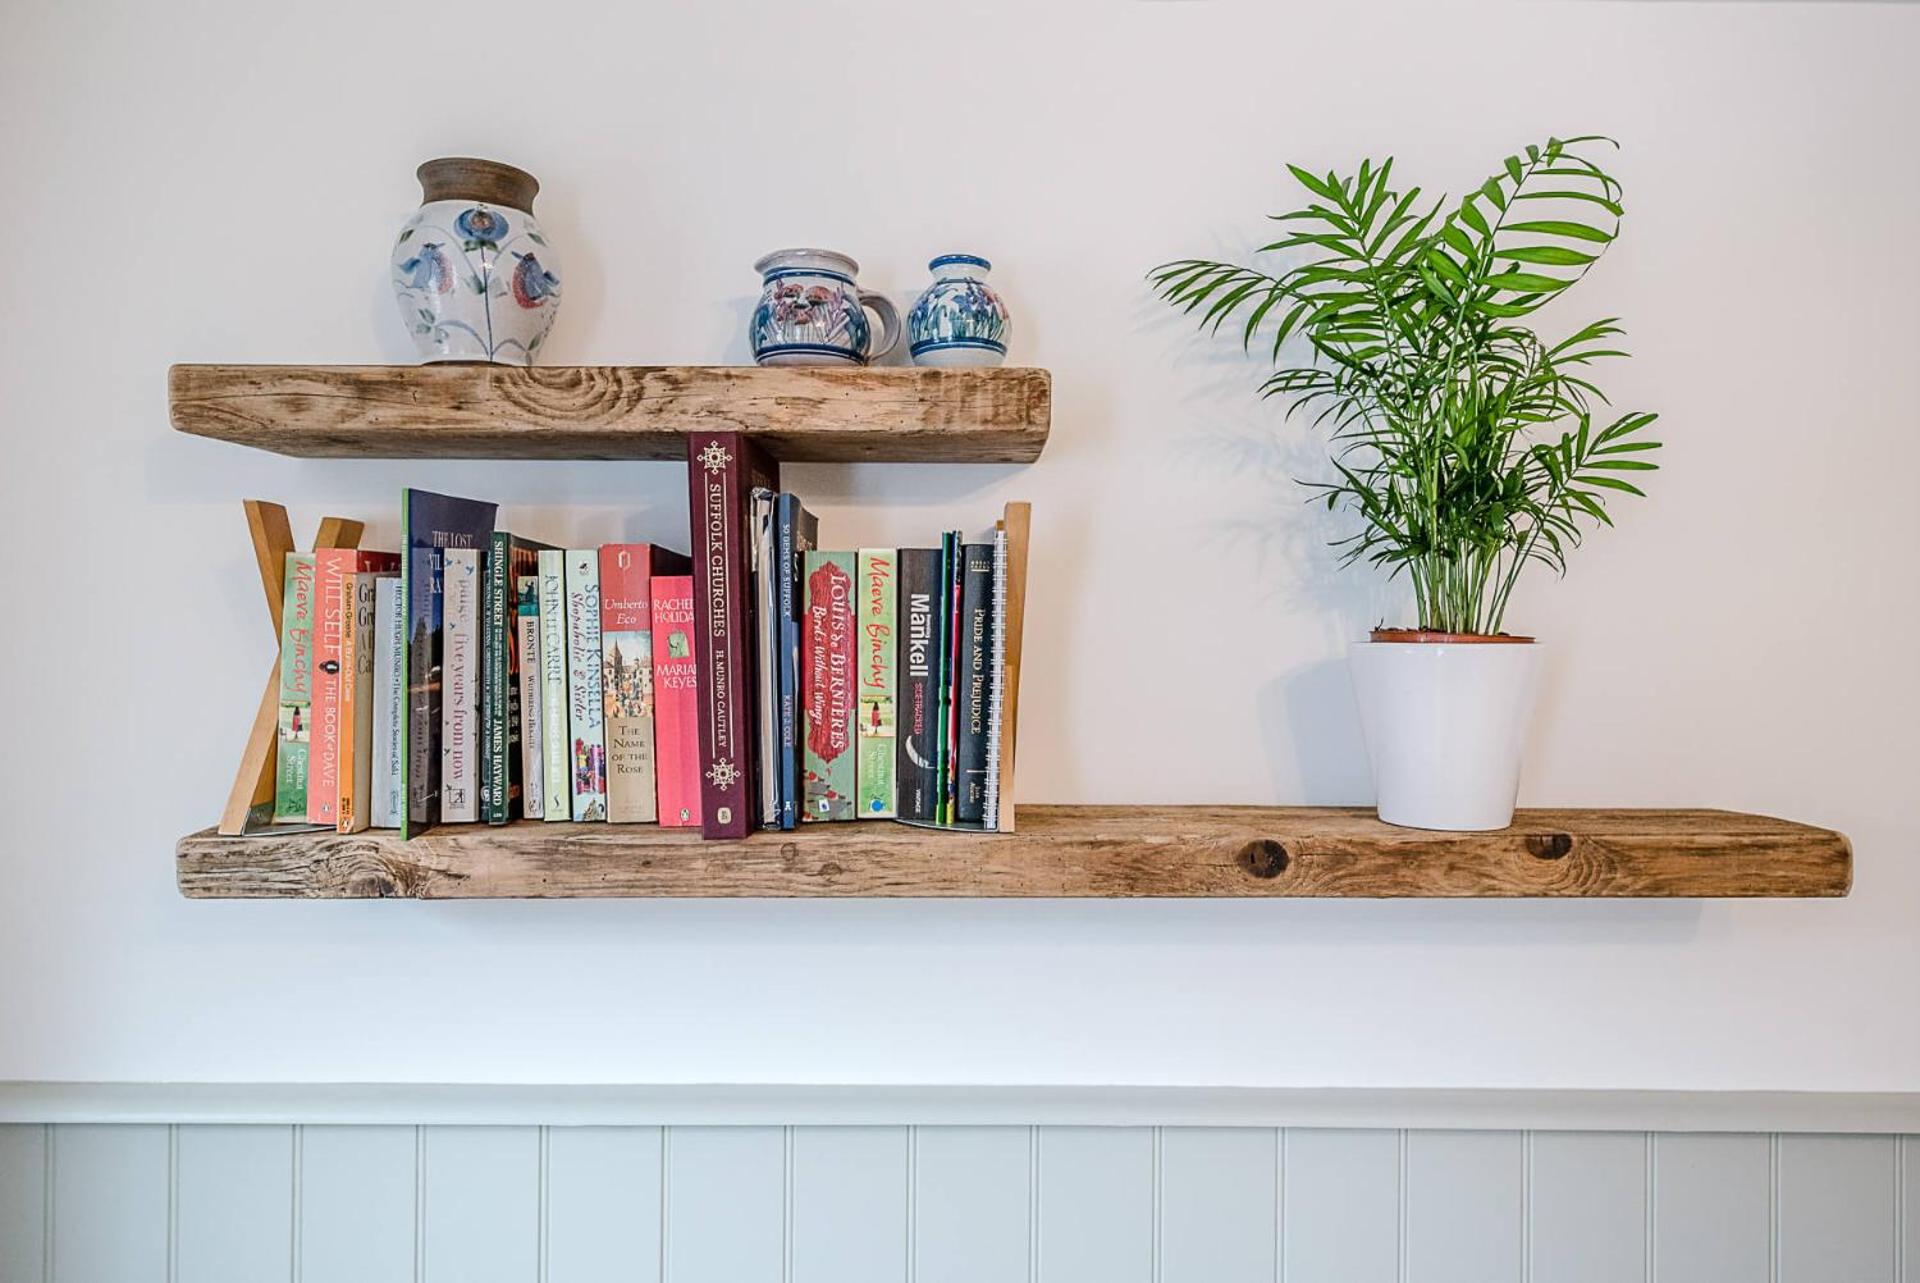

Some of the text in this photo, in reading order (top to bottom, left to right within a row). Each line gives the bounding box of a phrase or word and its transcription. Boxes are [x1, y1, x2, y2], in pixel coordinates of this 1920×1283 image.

[432, 531, 473, 547] THE LOST
[494, 541, 504, 586] SHINGLE
[710, 483, 725, 637] SUFFOLK CHURCHES
[783, 562, 791, 575] OF
[323, 557, 341, 653] WILL SELF
[394, 585, 402, 618] HECTOR
[494, 588, 504, 625] STREET
[545, 574, 559, 614] JOHN
[604, 599, 649, 610] Umberto
[783, 576, 791, 617] SUFFOLK
[831, 574, 846, 631] LOUIS
[285, 560, 314, 693] Maeve Binchy
[572, 592, 586, 663] Shopaholic
[617, 613, 637, 625] Eco
[864, 557, 890, 689] Maeve Binchy
[910, 594, 930, 677] Mankell
[585, 584, 601, 729] SOPHIE KINSELLA
[809, 605, 829, 725] Birds Without Wings
[971, 608, 985, 735] PRIDE AND PREJUDICE
[324, 680, 336, 703] THE
[663, 676, 697, 689] KEYES
[716, 661, 726, 699] MUNRO
[451, 633, 470, 780] five years from now
[574, 684, 587, 721] Sister
[324, 707, 336, 743] BOOK
[493, 720, 503, 753] JAMES
[618, 725, 640, 736] THE
[717, 701, 727, 747] CAUTLEY
[611, 753, 624, 761] OF
[613, 739, 645, 749] NAME
[321, 751, 335, 787] DAVE
[493, 755, 502, 806] HAYWARD
[617, 764, 643, 774] ROSE
